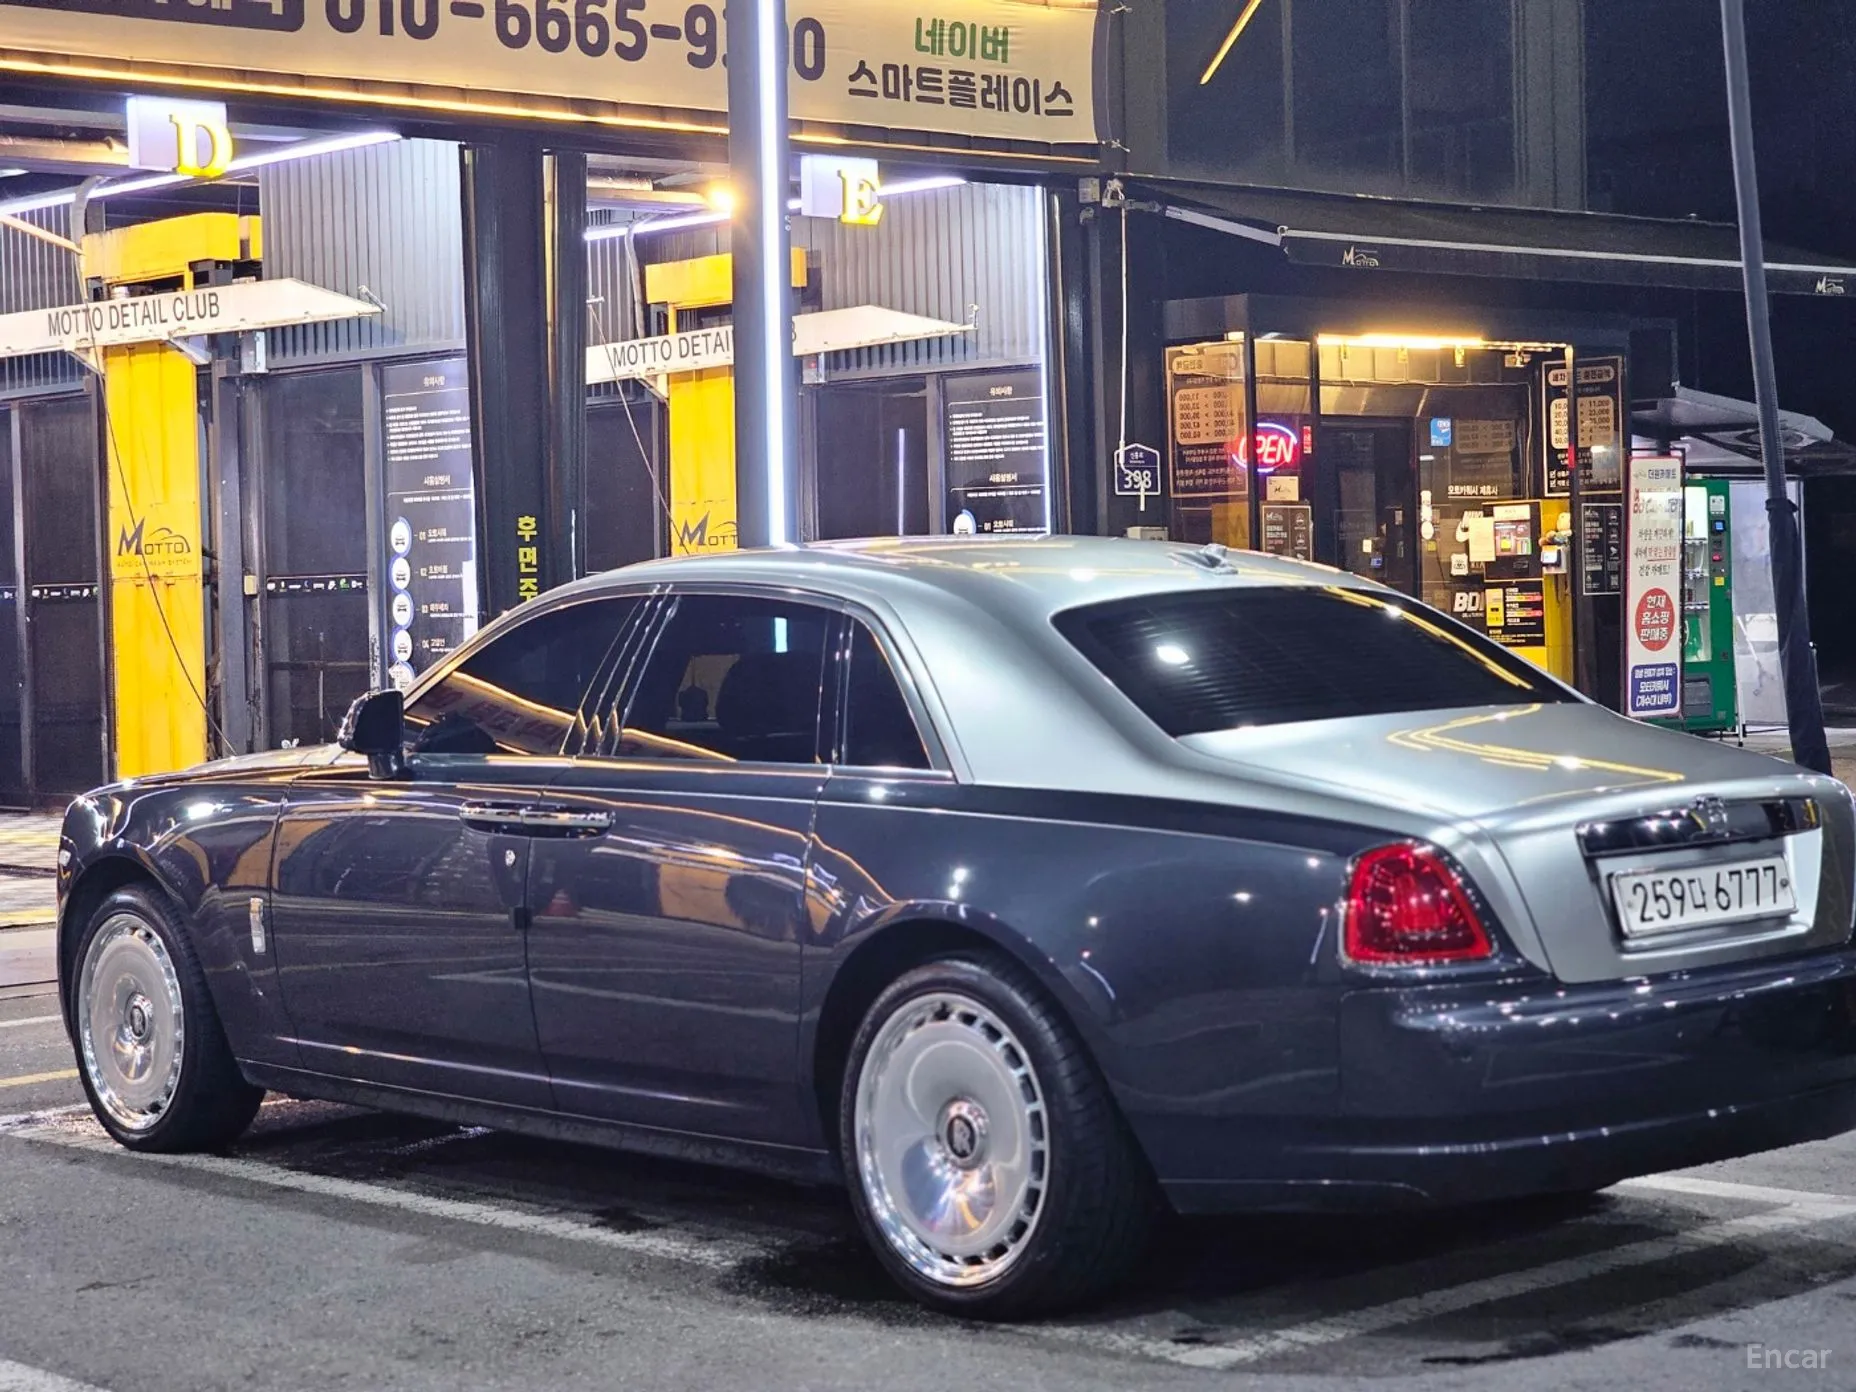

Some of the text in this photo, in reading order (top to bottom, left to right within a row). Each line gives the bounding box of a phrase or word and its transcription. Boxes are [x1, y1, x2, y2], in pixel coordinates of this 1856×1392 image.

[325, 0, 825, 81] 010-6665-90
[915, 17, 1009, 64] 네이버
[848, 60, 1074, 117] 스마트플레이스
[170, 113, 233, 177] D
[837, 168, 884, 225] E
[48, 292, 220, 336] MOTTO DETAIL CLUB
[613, 331, 734, 368] MOTTO DETAI
[1123, 470, 1152, 489] 398
[117, 516, 185, 556] MOTTO
[680, 510, 738, 547] MOTT
[1641, 611, 1670, 626] 홈쇼핑
[1647, 595, 1667, 609] 현재
[1640, 627, 1669, 642] 판매중
[1715, 866, 1777, 911] 6777
